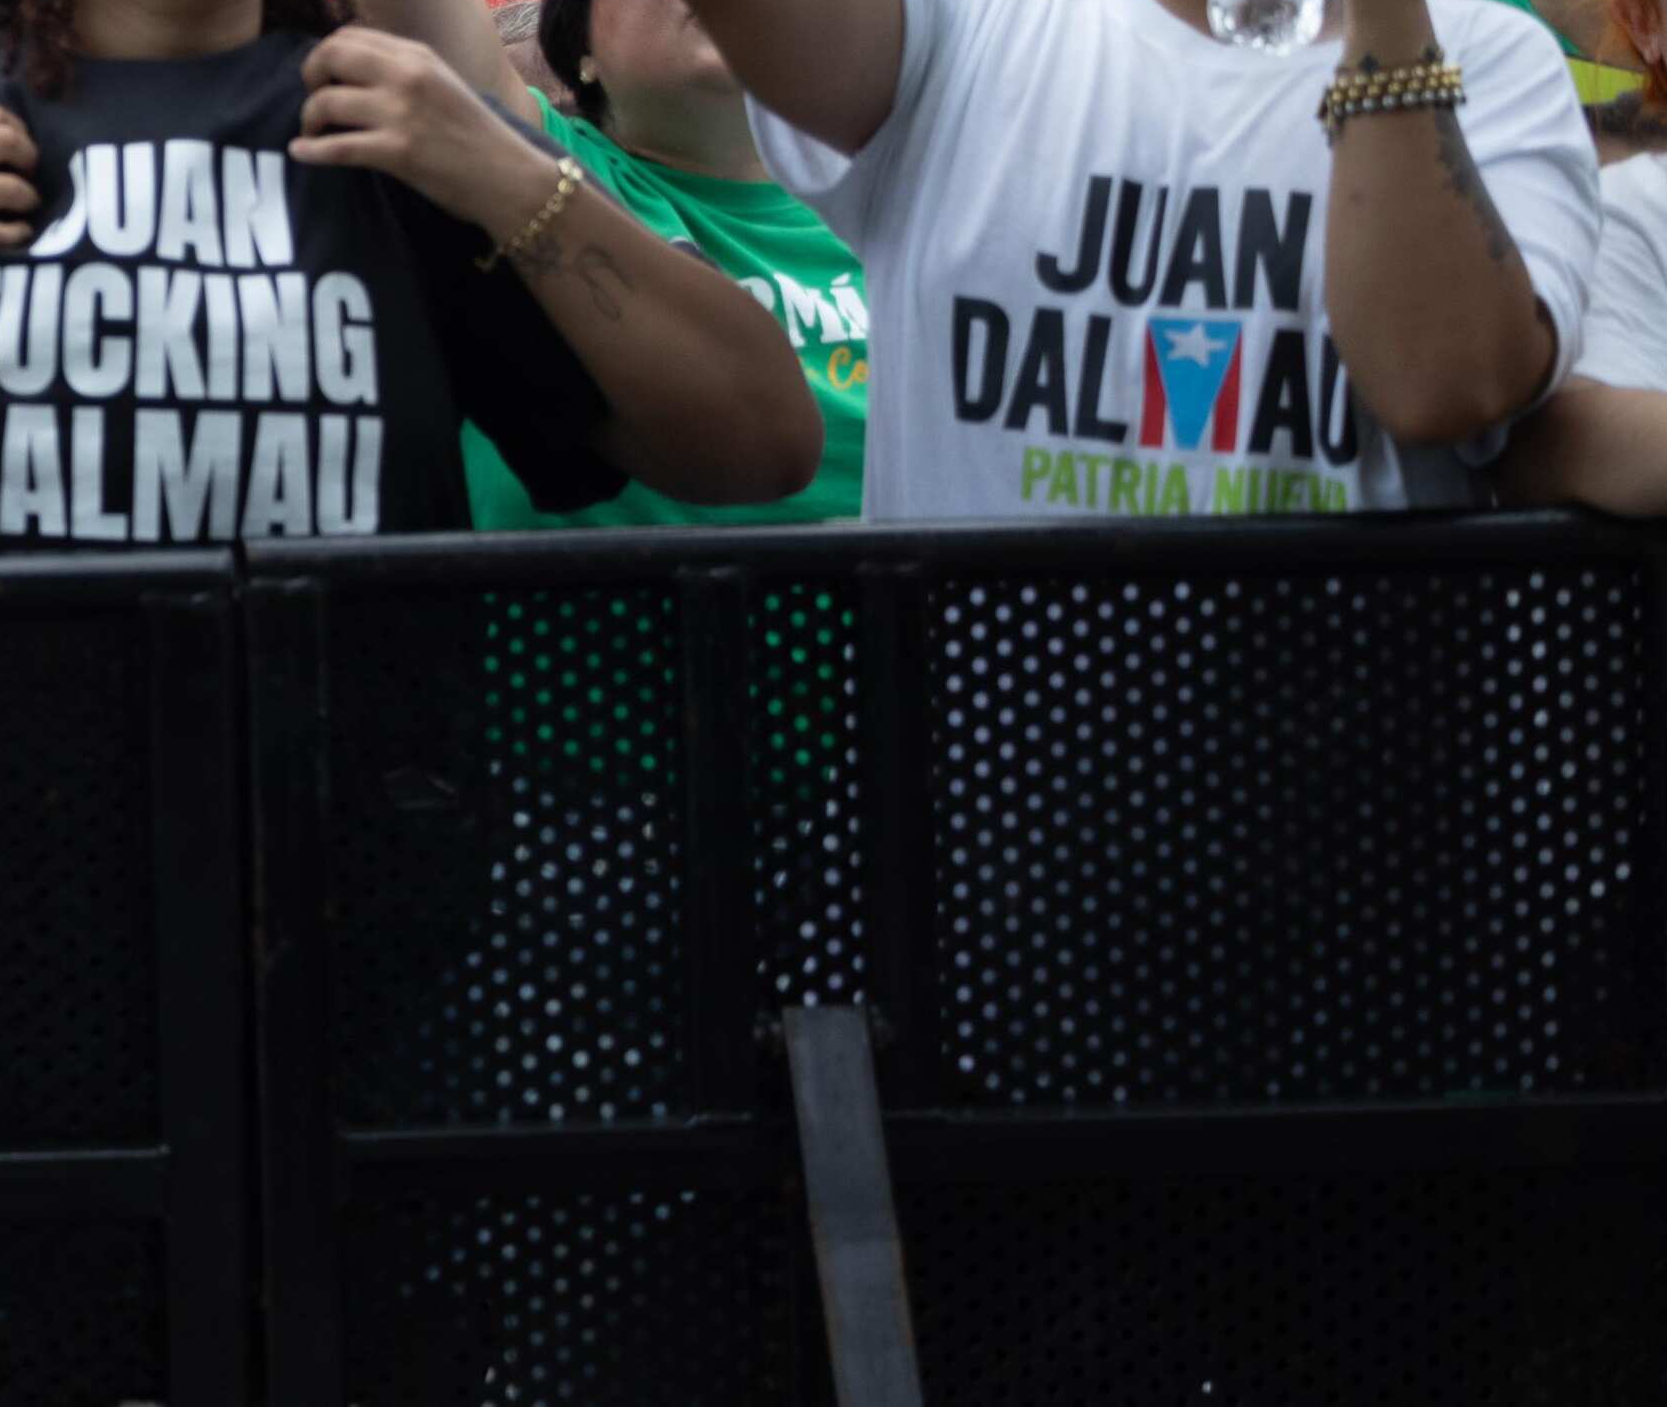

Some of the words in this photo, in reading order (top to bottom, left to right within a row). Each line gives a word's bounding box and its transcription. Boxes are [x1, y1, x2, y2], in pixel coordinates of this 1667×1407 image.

[30, 138, 293, 270] JUAN
[1036, 175, 1312, 310] JUAN
[952, 296, 1361, 467] DALMAU
[1021, 446, 1190, 515] PATRIA
